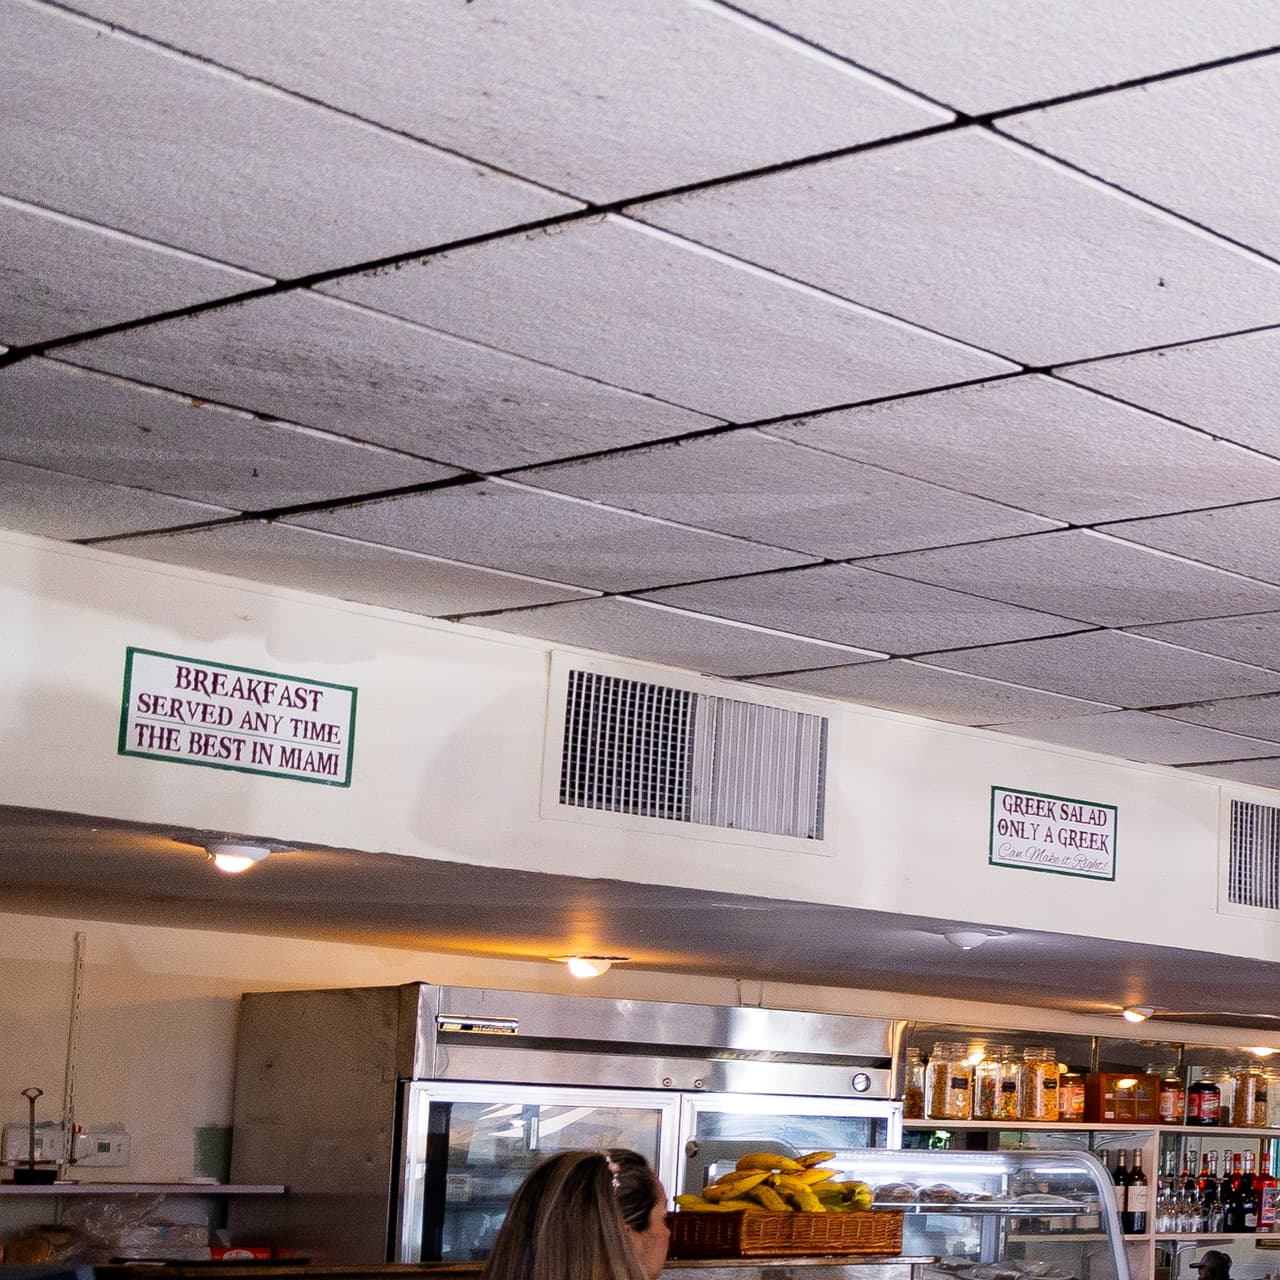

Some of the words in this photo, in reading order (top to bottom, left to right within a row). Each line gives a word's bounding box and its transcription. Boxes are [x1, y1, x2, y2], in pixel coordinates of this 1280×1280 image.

[175, 665, 323, 712] BREAKFAST
[137, 692, 233, 726] SERVED
[240, 710, 284, 735] ANY
[290, 718, 341, 745] TIME
[135, 723, 181, 751] THE
[189, 731, 246, 759] BEST
[251, 741, 274, 766] IN
[280, 746, 339, 776] MIAMI
[1002, 794, 1057, 822] GREEK
[1060, 803, 1107, 827] SALAD
[998, 818, 1041, 841] ONLY
[1044, 826, 1053, 843] A
[1058, 828, 1110, 856] GREEK
[998, 842, 1023, 858] Can
[1025, 847, 1060, 865] Make
[1061, 855, 1071, 865] it
[1072, 853, 1109, 872] Right!
